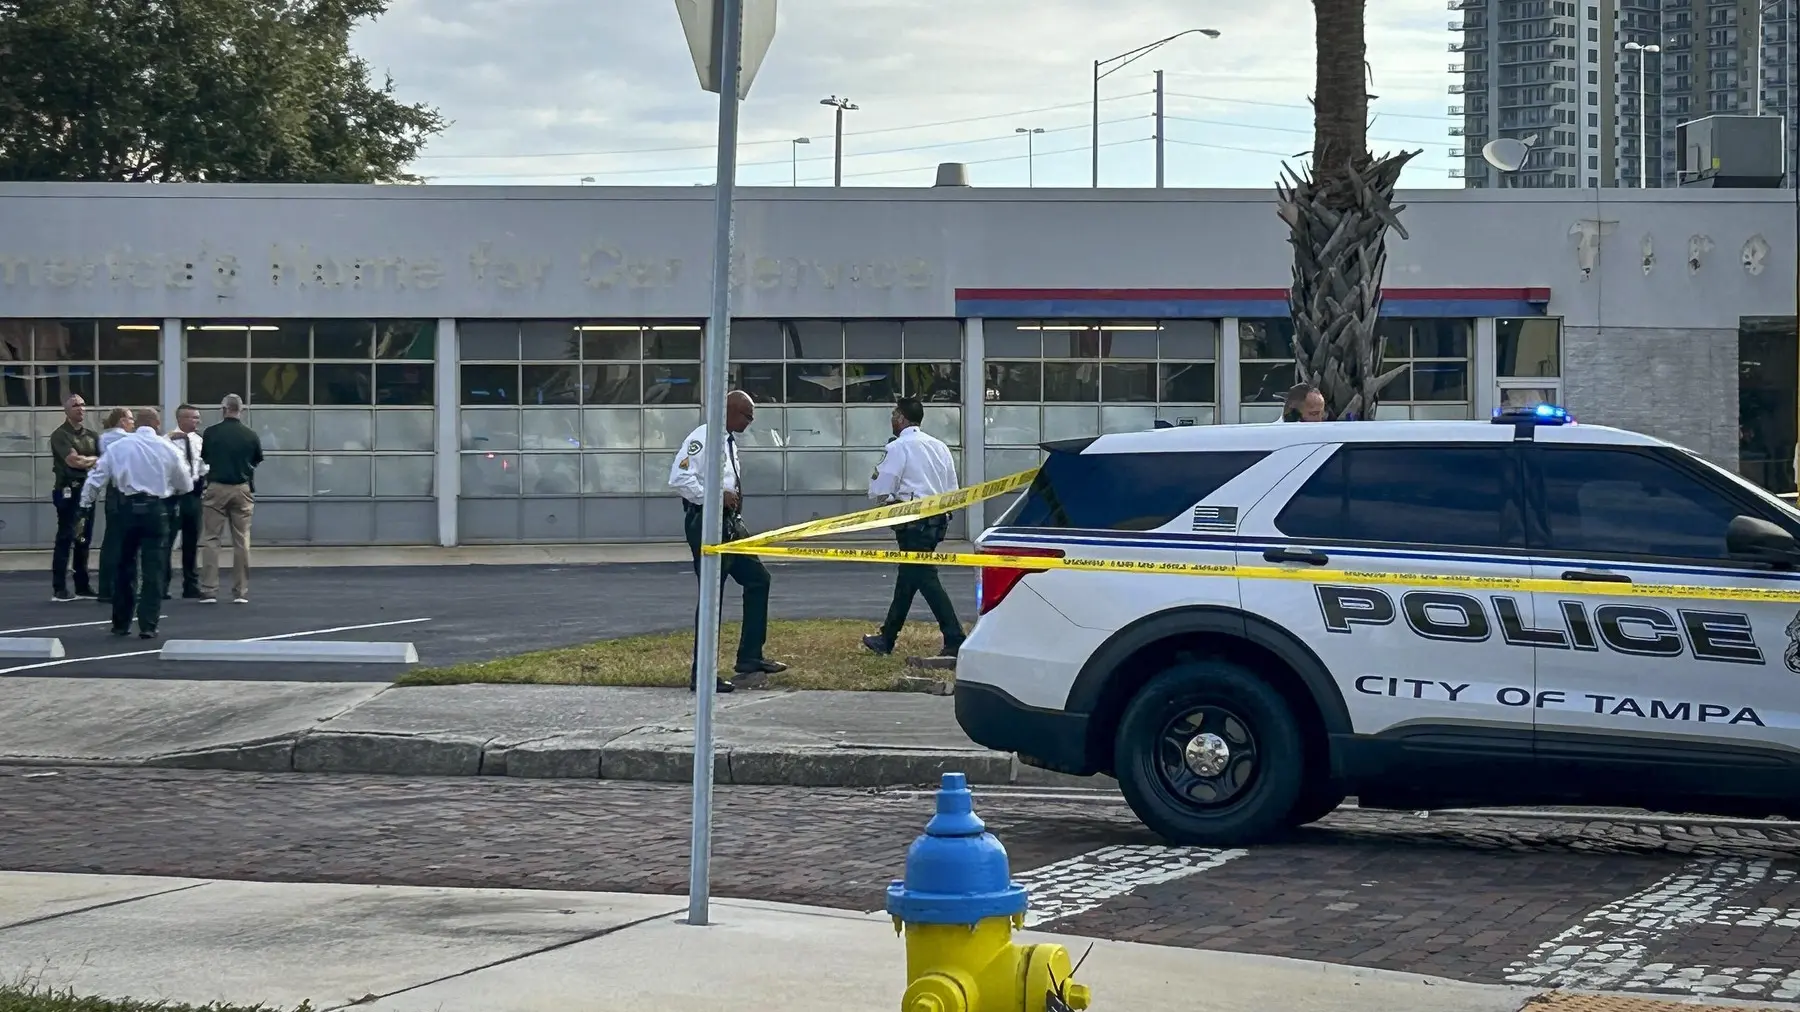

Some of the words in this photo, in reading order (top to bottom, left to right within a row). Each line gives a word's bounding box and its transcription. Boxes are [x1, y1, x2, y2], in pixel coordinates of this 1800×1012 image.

[269, 242, 446, 290] Home
[469, 239, 554, 290] for
[1314, 583, 1767, 665] POLICE
[1355, 674, 1470, 702] CITY
[1496, 686, 1566, 709] OF
[1585, 694, 1767, 727] TAMPA
